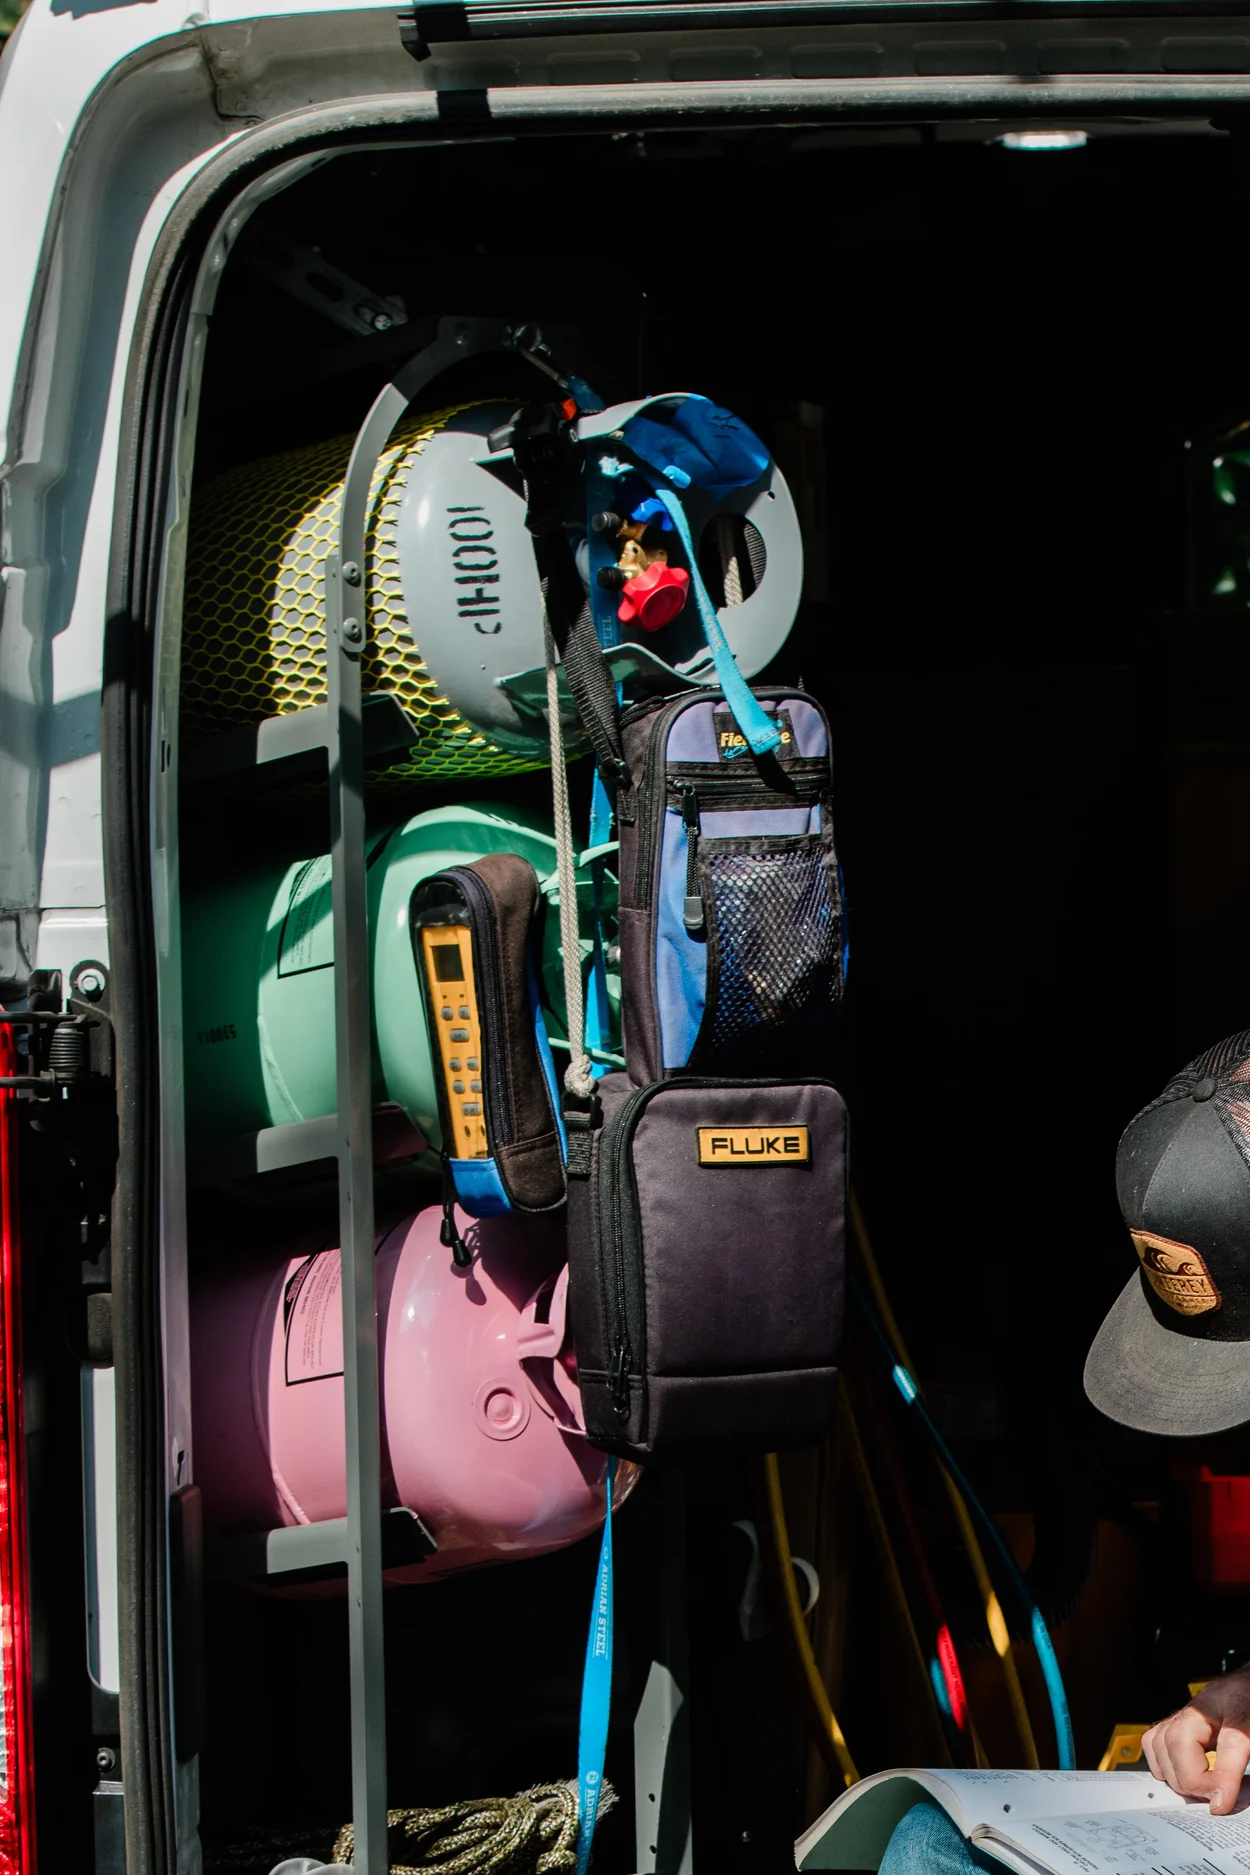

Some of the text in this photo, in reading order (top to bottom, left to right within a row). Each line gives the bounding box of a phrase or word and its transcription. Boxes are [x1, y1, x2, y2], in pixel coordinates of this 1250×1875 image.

[711, 1137, 800, 1156] FLUKE
[596, 1564, 608, 1656] ADRIAN STEEL
[584, 1788, 596, 1837] ADRIAN
